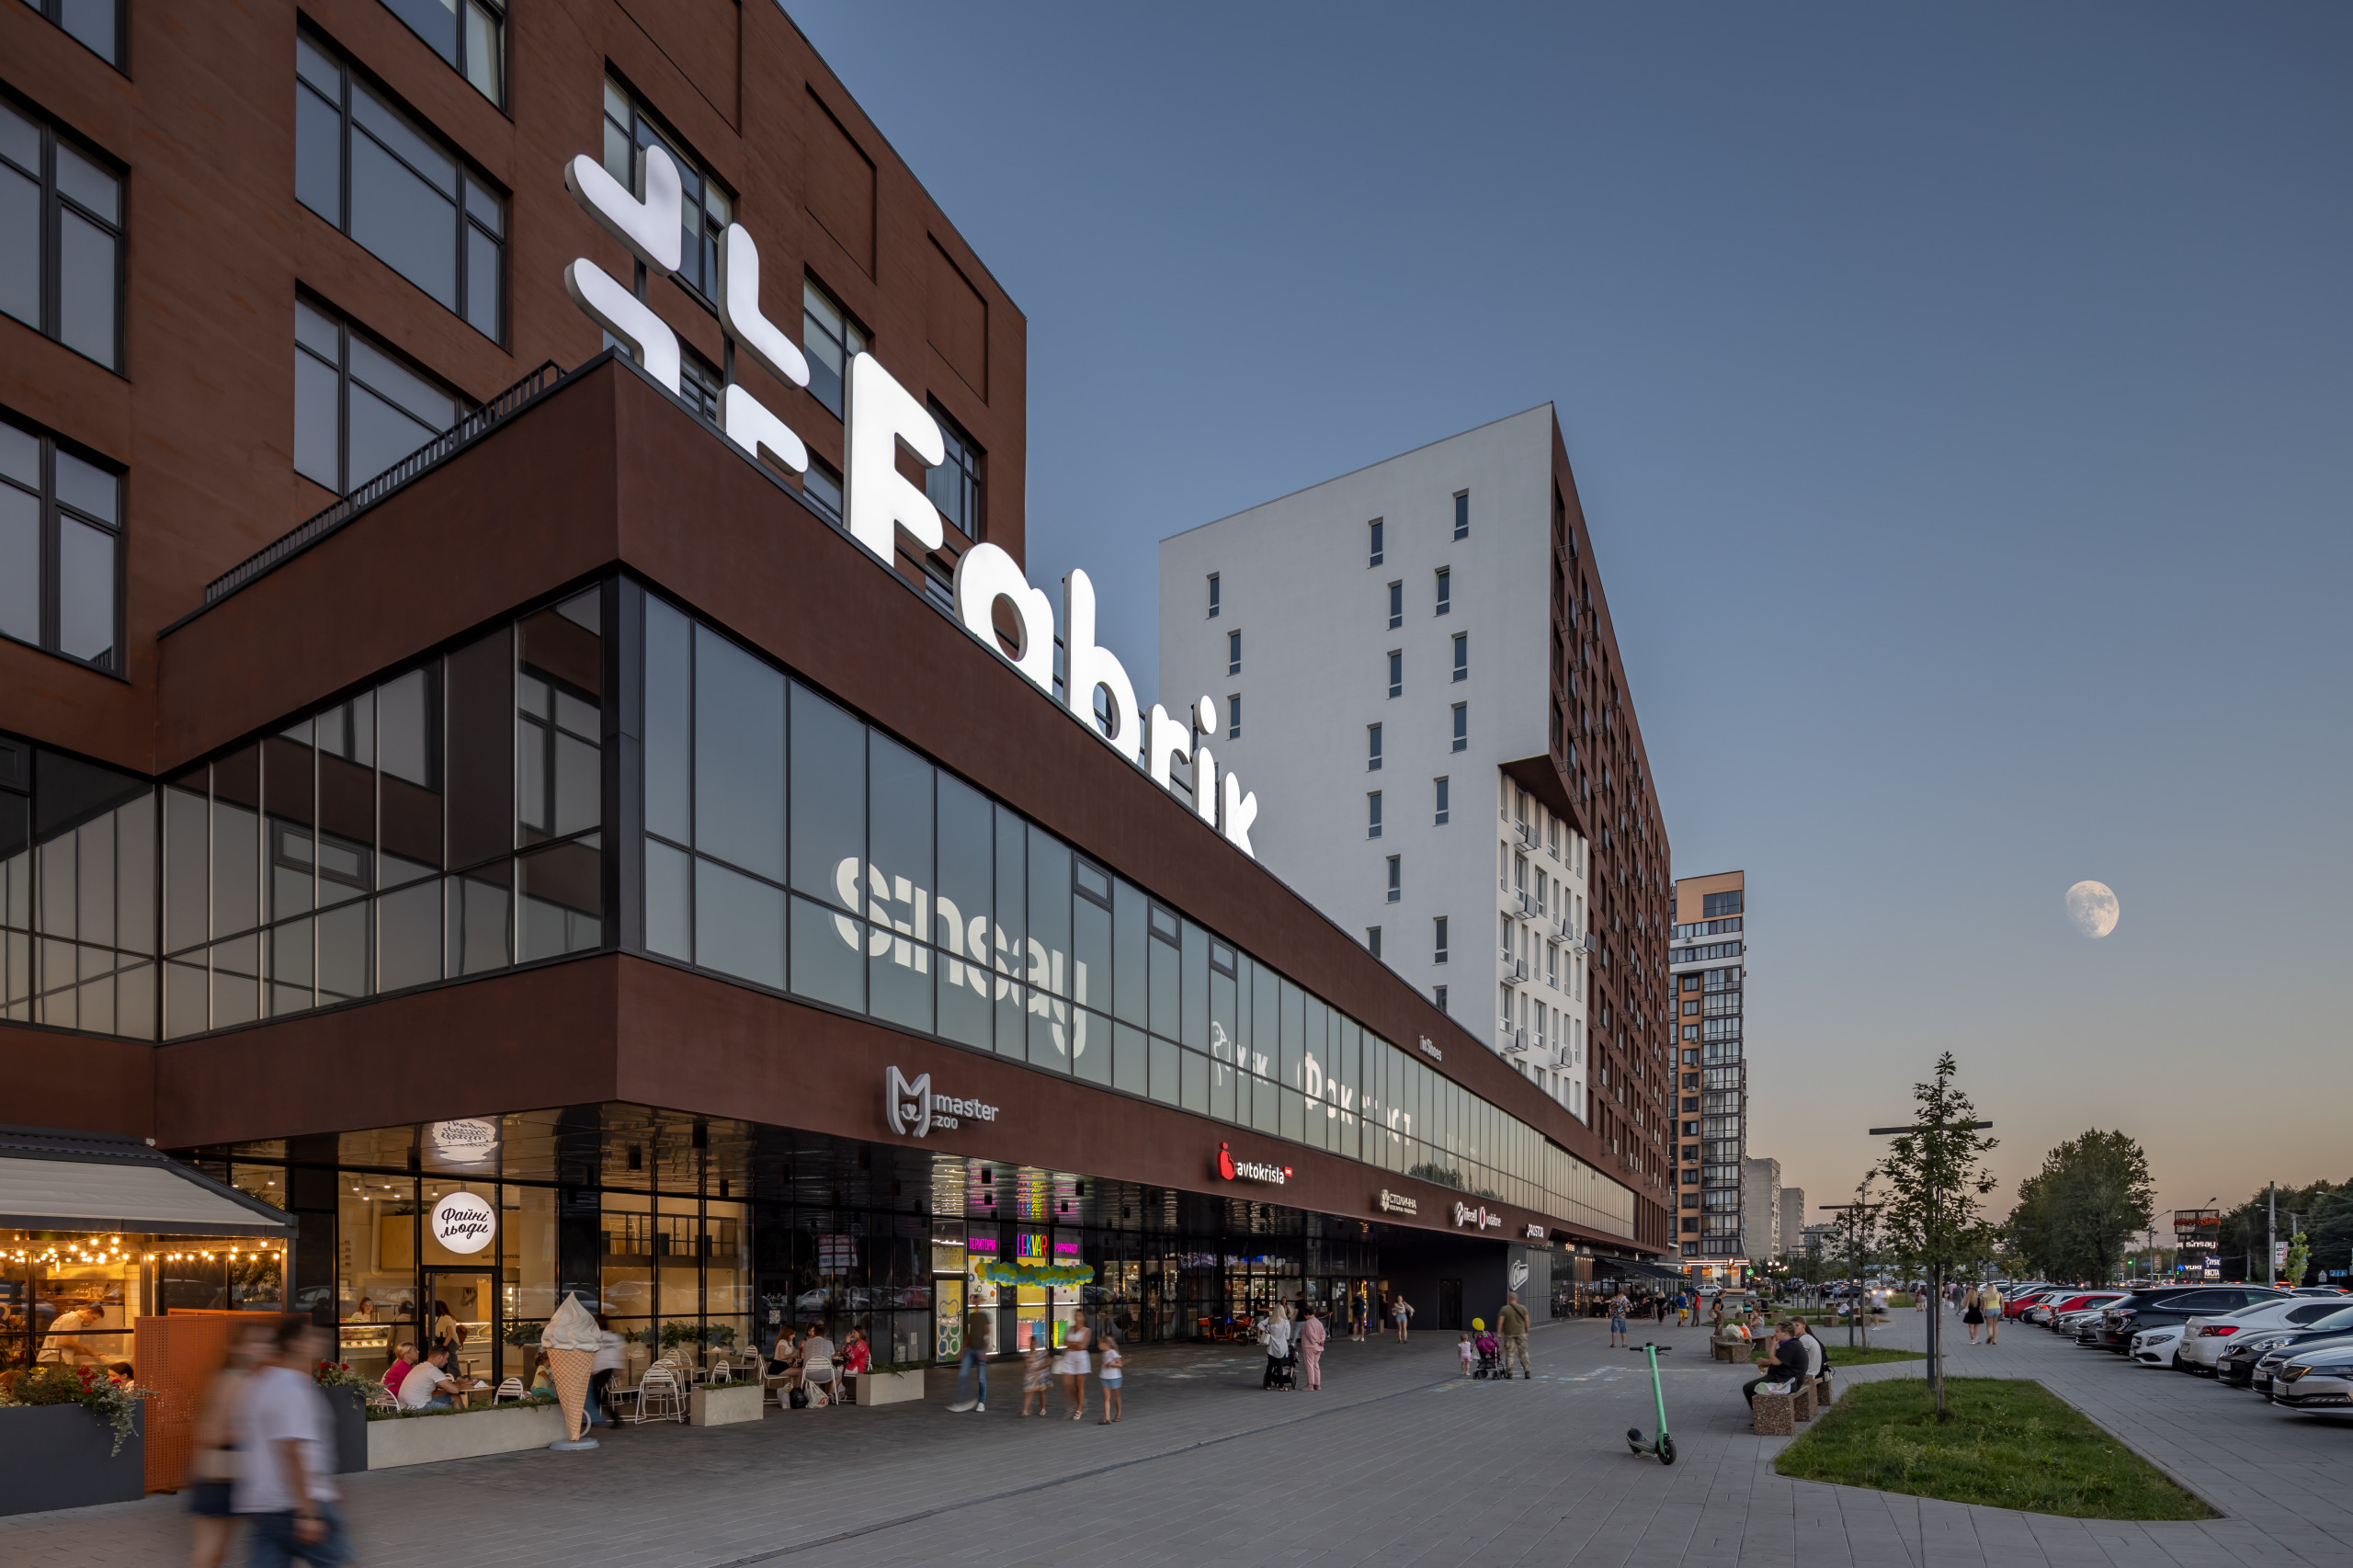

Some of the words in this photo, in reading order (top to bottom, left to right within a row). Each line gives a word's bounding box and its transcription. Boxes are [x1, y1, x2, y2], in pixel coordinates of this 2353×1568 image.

[843, 350, 1258, 860] Fabrik
[833, 857, 1087, 1060] sinsay
[934, 1094, 1000, 1122] master
[935, 1115, 959, 1130] zoo
[1236, 1161, 1286, 1185] avtokrisla
[440, 1207, 490, 1225] Файні
[439, 1222, 489, 1240] льоди
[2185, 1240, 2216, 1250] sinsay
